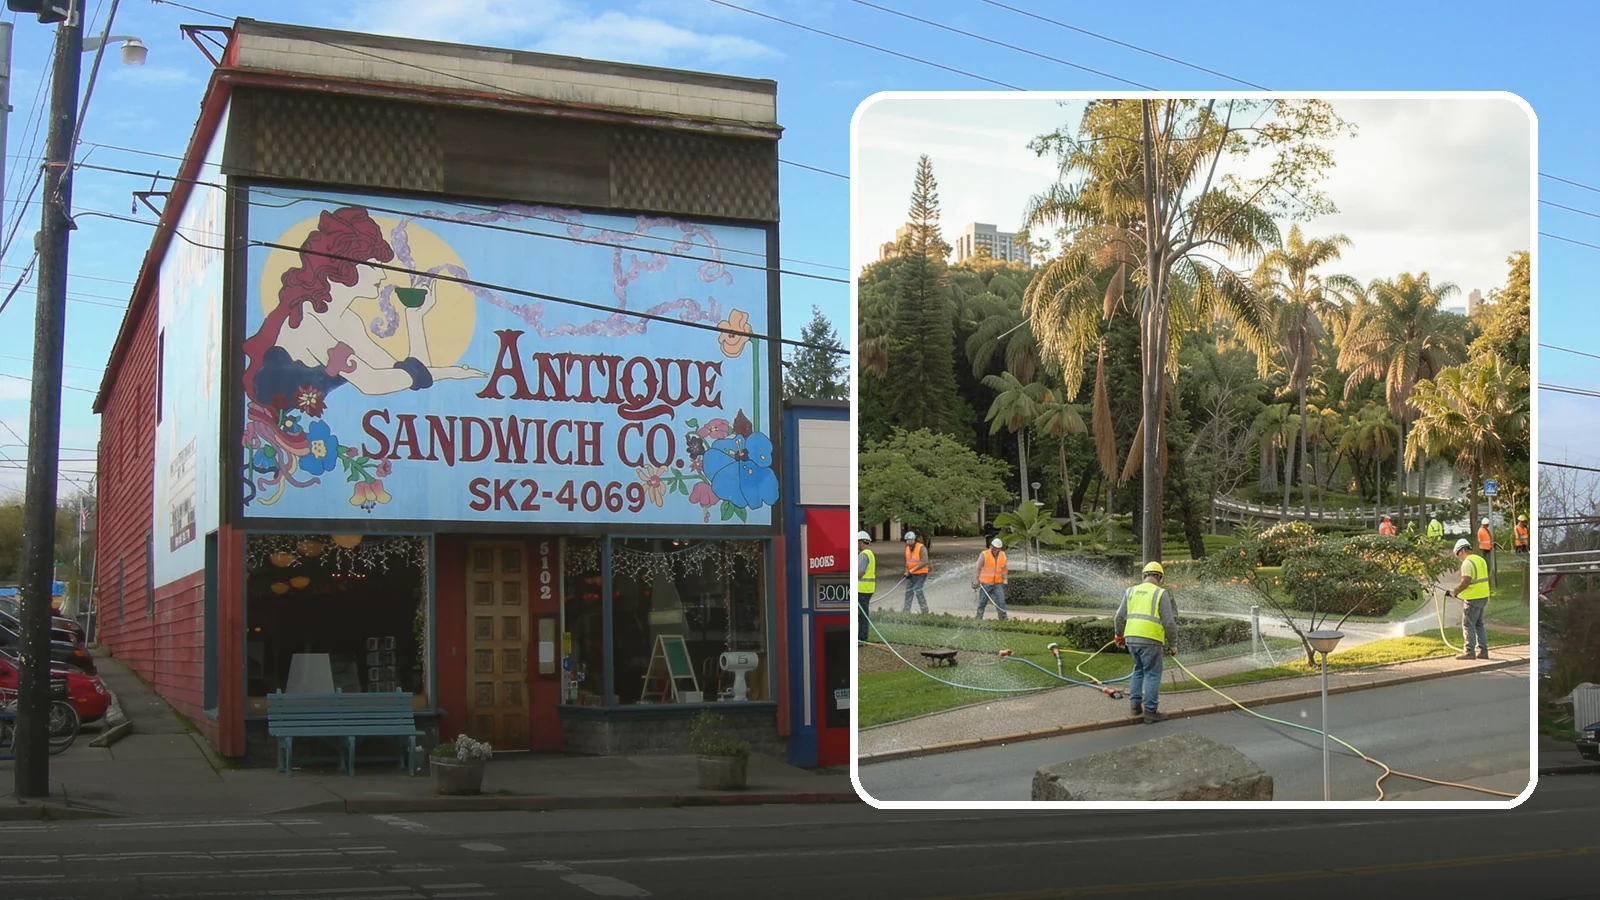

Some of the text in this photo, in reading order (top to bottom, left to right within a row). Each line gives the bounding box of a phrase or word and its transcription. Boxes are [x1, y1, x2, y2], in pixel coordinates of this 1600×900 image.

[476, 329, 723, 421] ANTIQUE
[361, 409, 685, 469] SANDWICH CO.
[468, 477, 645, 513] SK2-4069
[539, 542, 552, 599] 5102
[809, 555, 835, 569] BOOKS
